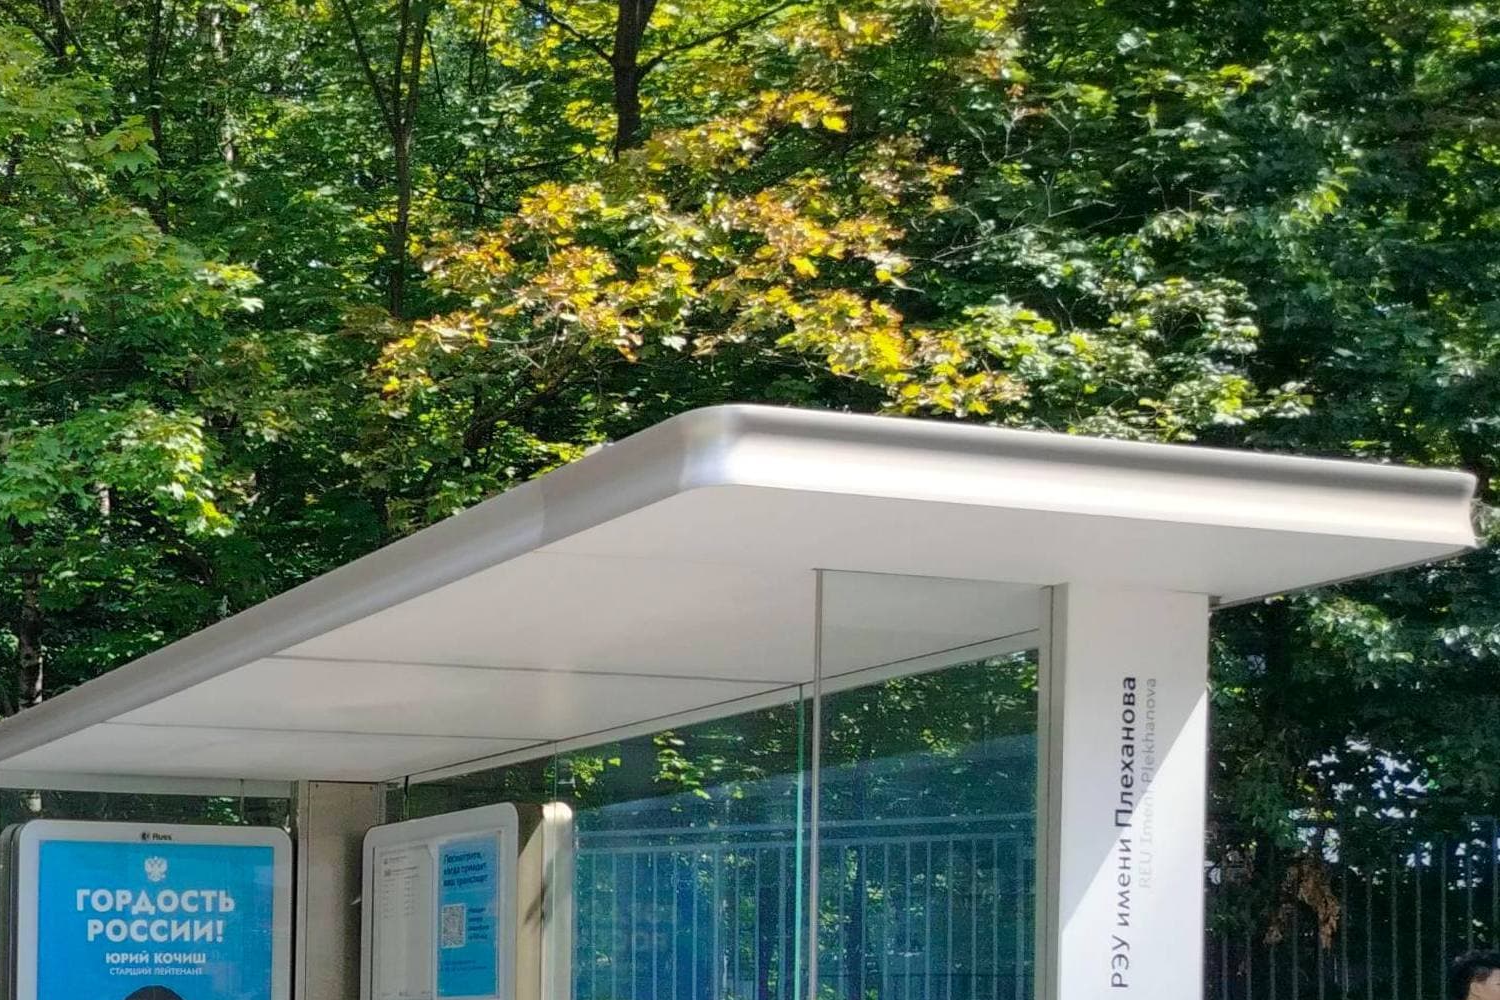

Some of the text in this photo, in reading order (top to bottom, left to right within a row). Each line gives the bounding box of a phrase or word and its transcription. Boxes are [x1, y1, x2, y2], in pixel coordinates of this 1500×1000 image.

[1141, 678, 1157, 784] Plekhanova
[1111, 676, 1136, 987] РЭУ имени Плеханова
[76, 888, 235, 915] ГОРДОСТЬ
[87, 919, 224, 943] РОССИИ!
[106, 950, 206, 964] ЮРИЙ КОЧИШ
[109, 967, 151, 976] СТАРШИЙ
